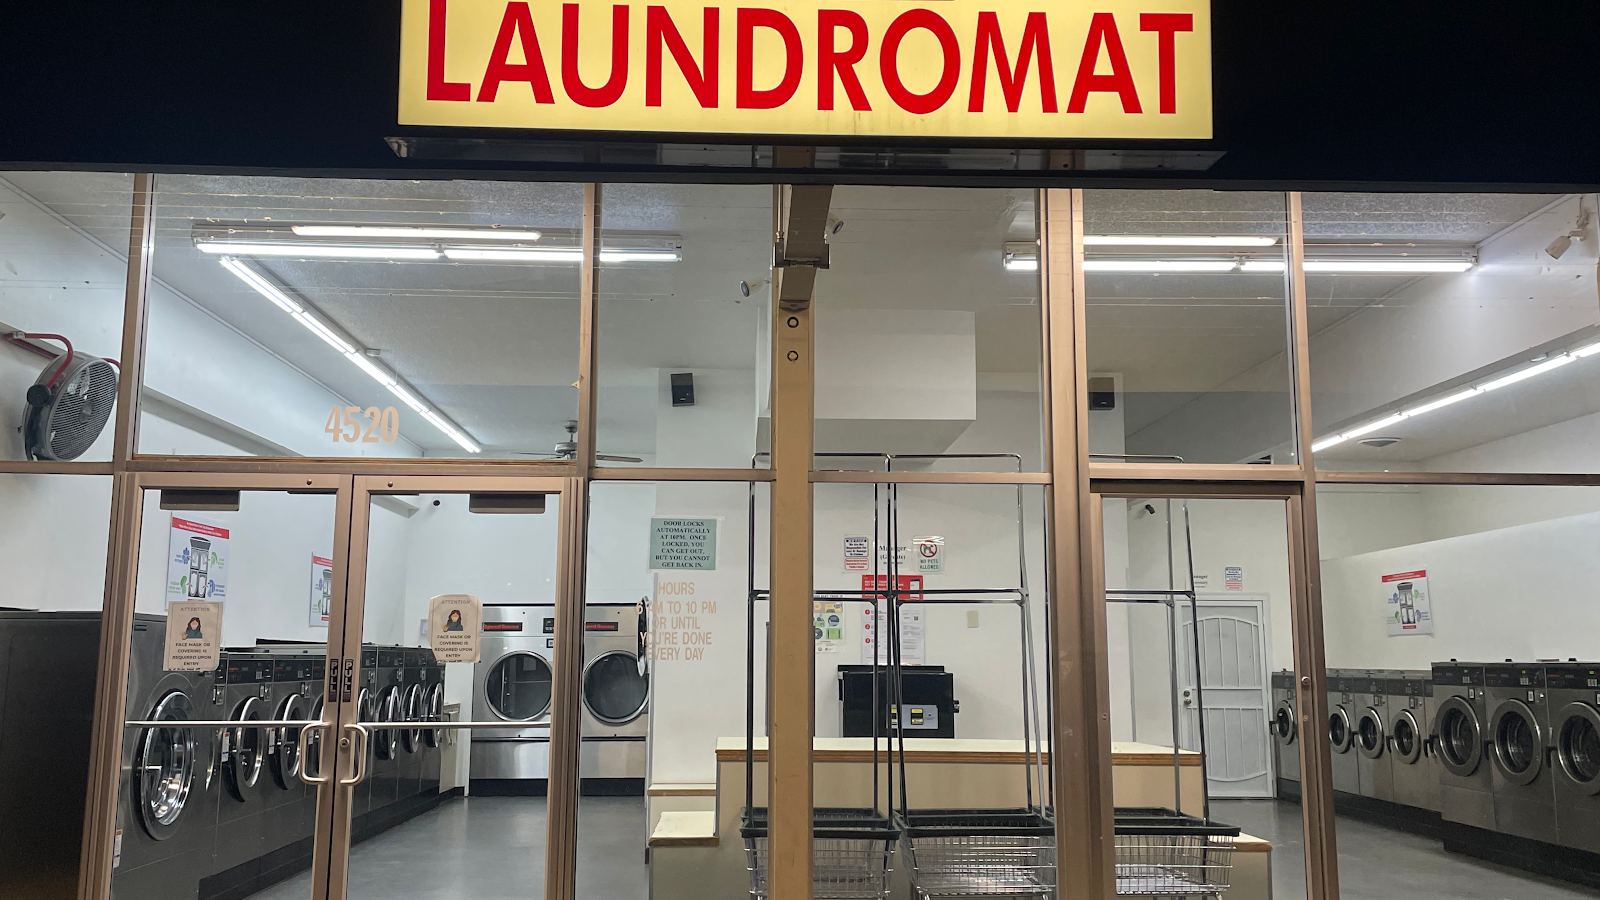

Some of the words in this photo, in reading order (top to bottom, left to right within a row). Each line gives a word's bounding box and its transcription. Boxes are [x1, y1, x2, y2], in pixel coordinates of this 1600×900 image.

[426, 0, 1194, 115] LAUNDROMAT
[324, 405, 400, 443] 4520
[658, 582, 695, 595] HOURS
[636, 601, 644, 615] 6
[647, 601, 664, 614] AM
[667, 601, 682, 614] TO
[686, 601, 697, 614] 10
[701, 601, 717, 614] PM
[651, 616, 667, 630] OR
[671, 616, 701, 630] UNTIL
[640, 632, 678, 646] YOU'RE
[682, 632, 712, 646] DONE
[646, 647, 680, 661] EVERY
[685, 647, 704, 661] DAY
[344, 662, 352, 692] PULL
